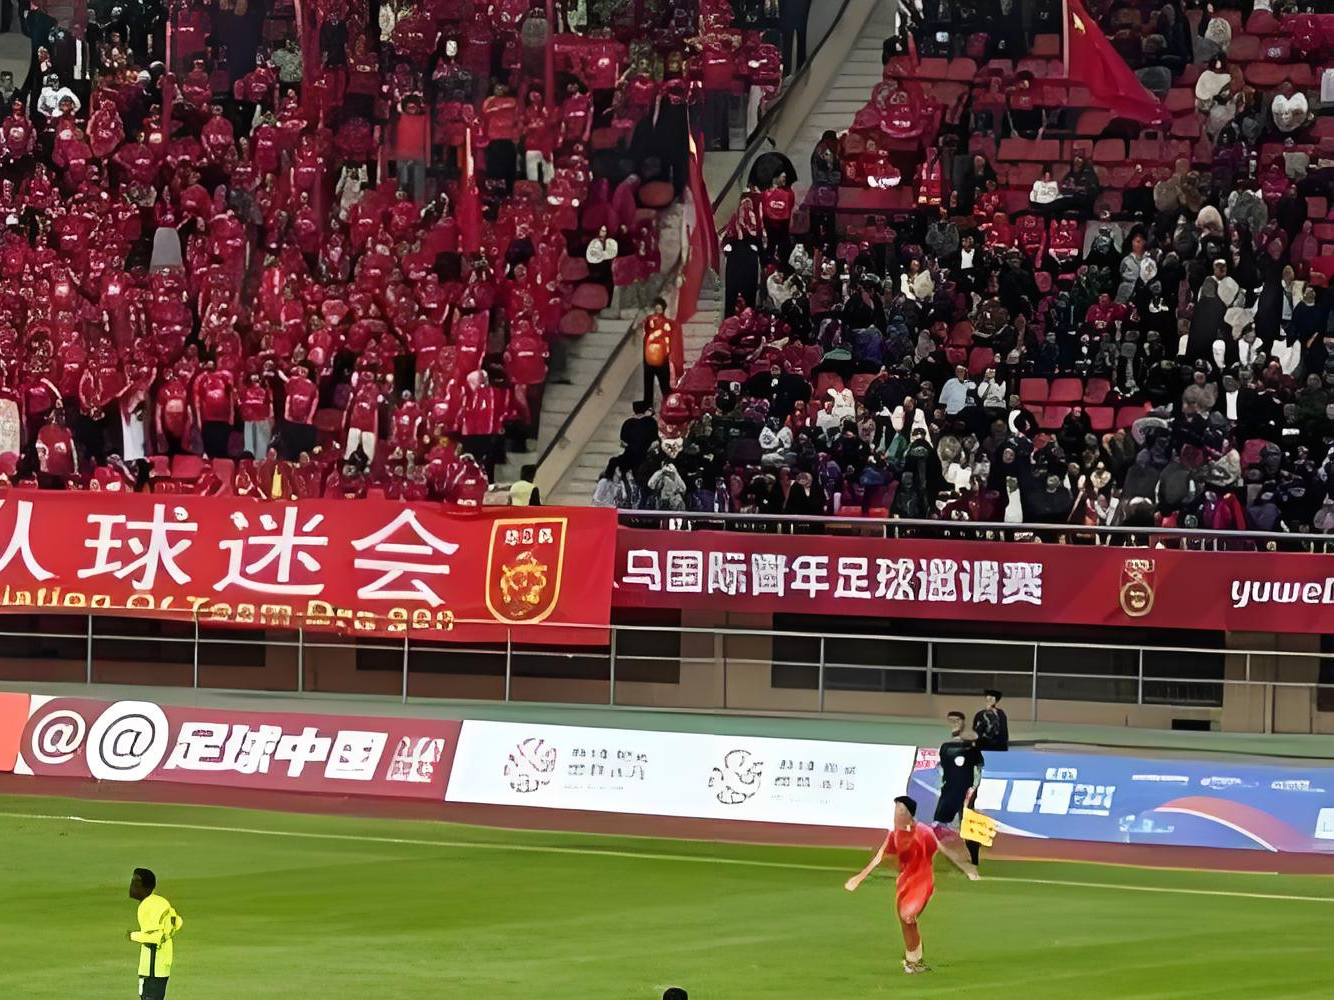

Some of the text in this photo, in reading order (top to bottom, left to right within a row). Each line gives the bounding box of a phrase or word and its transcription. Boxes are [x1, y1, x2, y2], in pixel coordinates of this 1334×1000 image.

[614, 549, 1043, 605] 马国际青年足球邀请赛
[1231, 576, 1334, 608] yuwel
